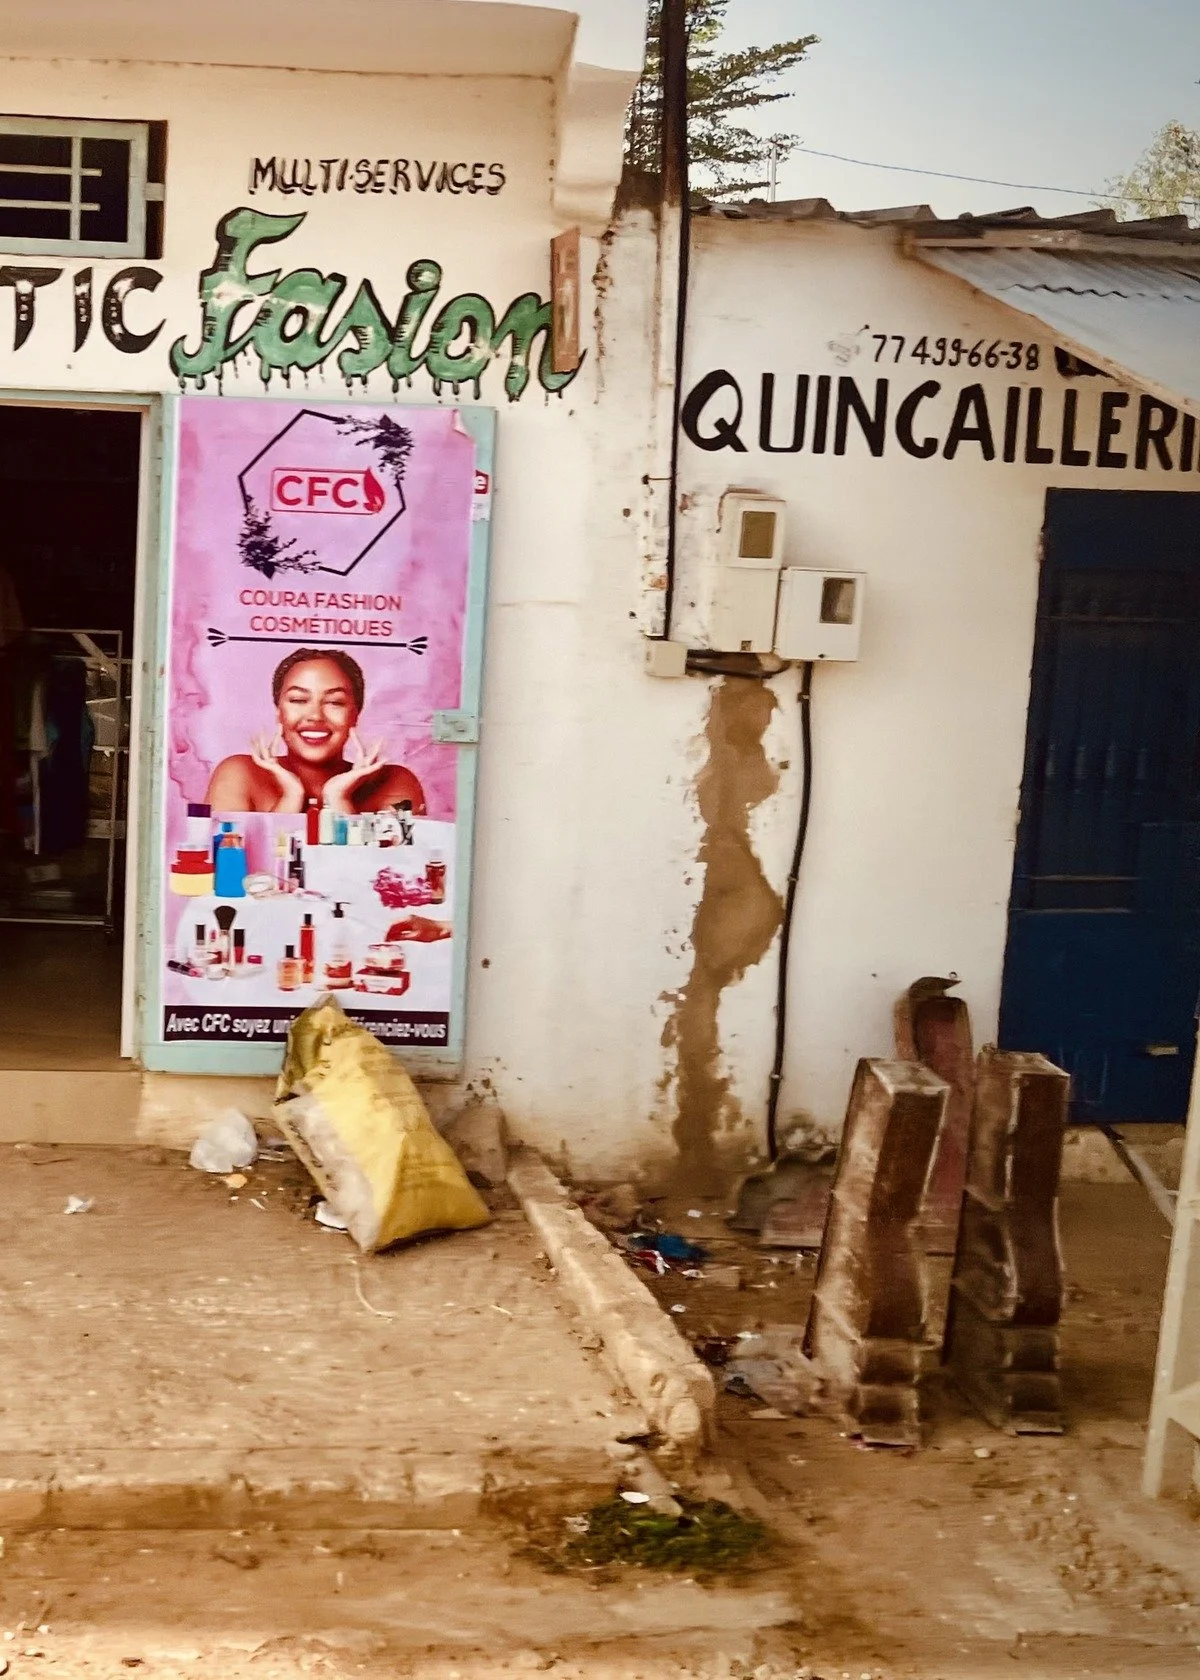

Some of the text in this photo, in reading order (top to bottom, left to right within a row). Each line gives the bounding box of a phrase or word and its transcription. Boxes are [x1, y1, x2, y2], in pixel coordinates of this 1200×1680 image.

[872, 334, 906, 364] 77
[681, 368, 1200, 474] QUINCAILLERI
[276, 475, 359, 508] CFC
[239, 589, 402, 611] COURA FASHION
[166, 1012, 200, 1032] Avec
[201, 1013, 231, 1033] CFC
[231, 1018, 271, 1038] soyez
